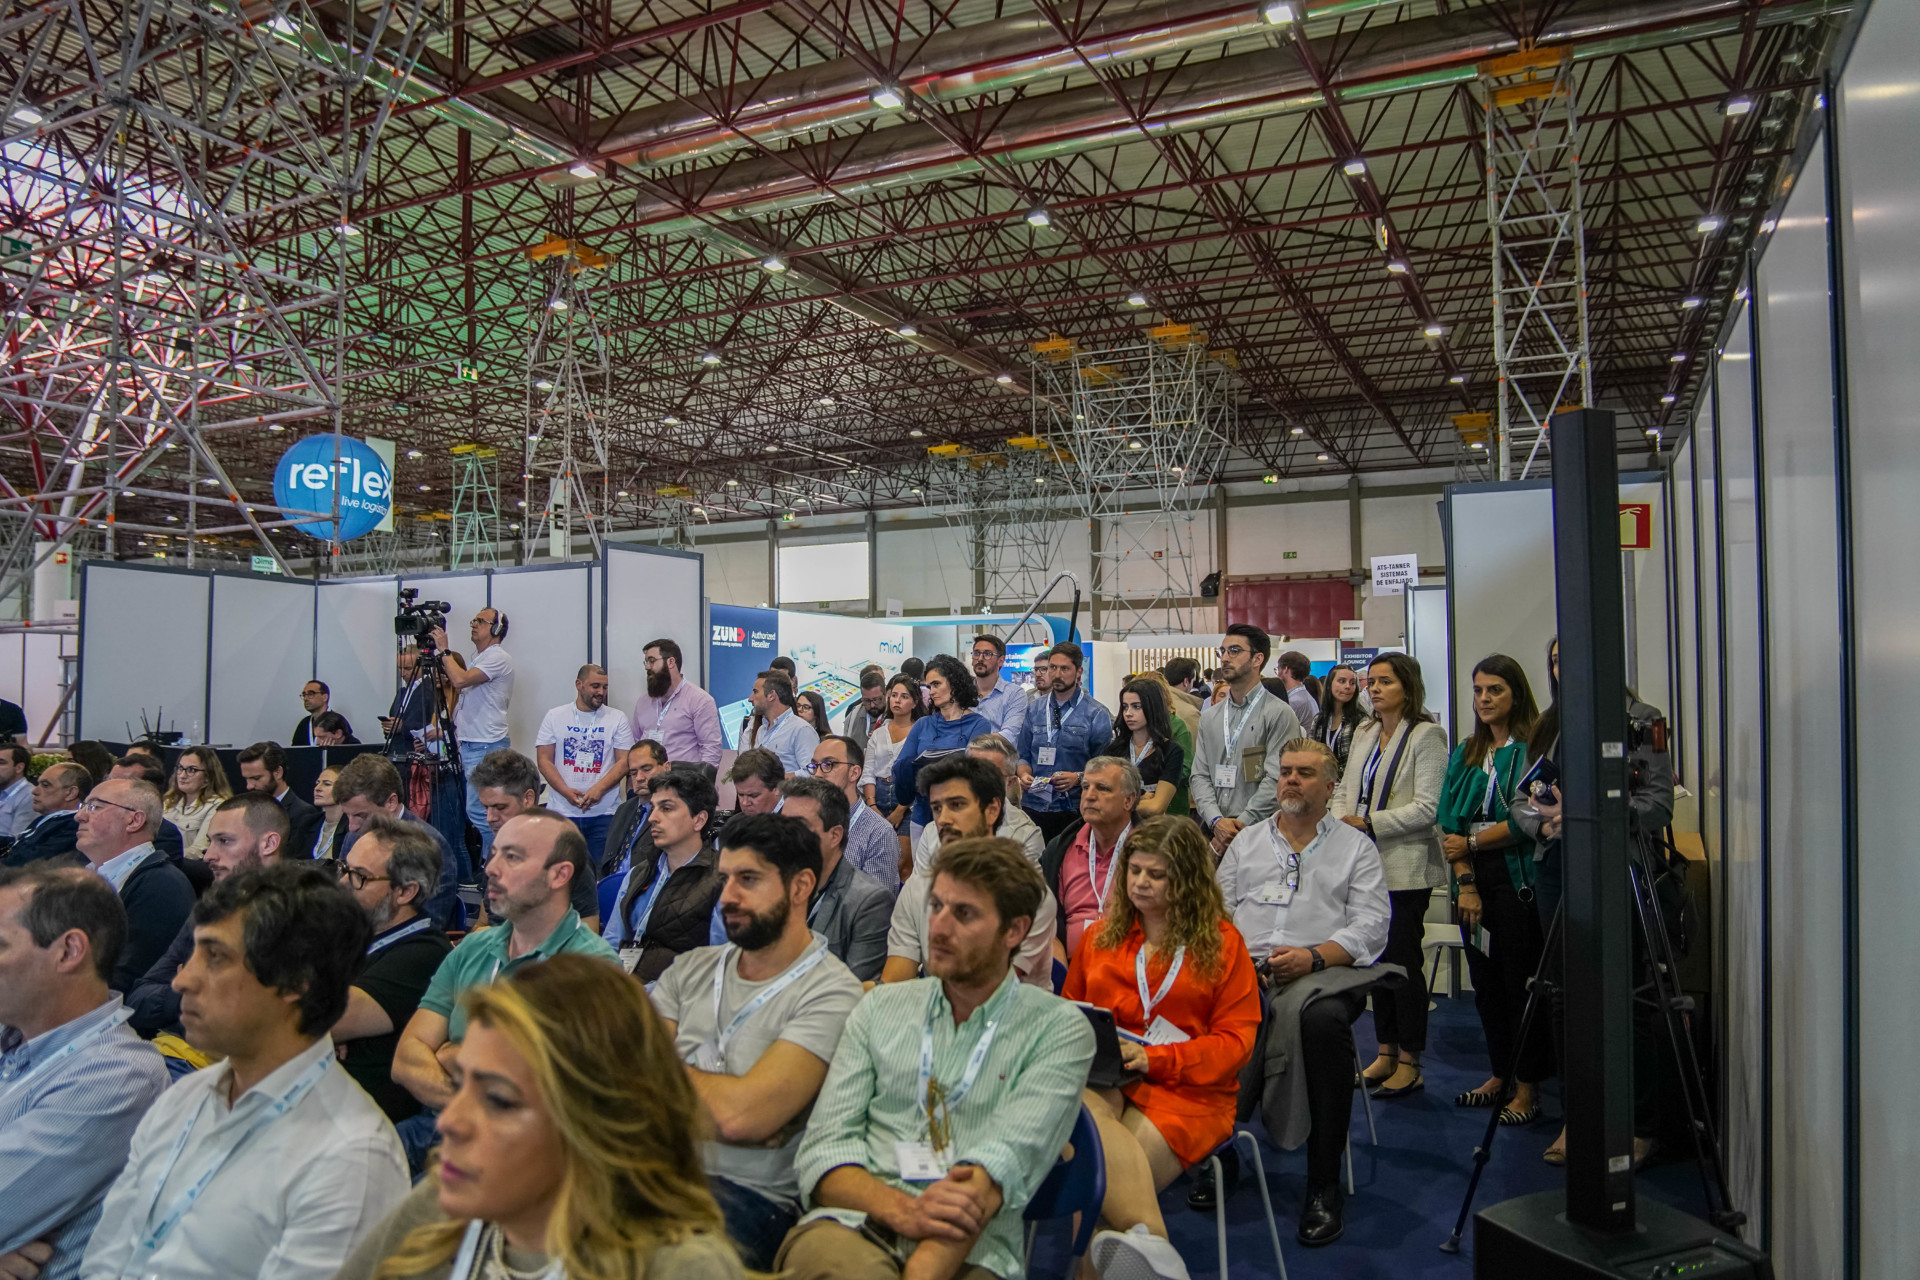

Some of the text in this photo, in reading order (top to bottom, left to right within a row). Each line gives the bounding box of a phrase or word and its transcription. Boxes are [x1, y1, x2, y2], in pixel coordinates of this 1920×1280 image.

[289, 457, 392, 502] reflex
[341, 495, 360, 508] live
[1380, 570, 1408, 578] SISTEMAS
[1385, 577, 1414, 585] ENFAJADO
[751, 630, 776, 640] Authorized
[751, 639, 770, 649] Reseller
[879, 636, 904, 654] mind
